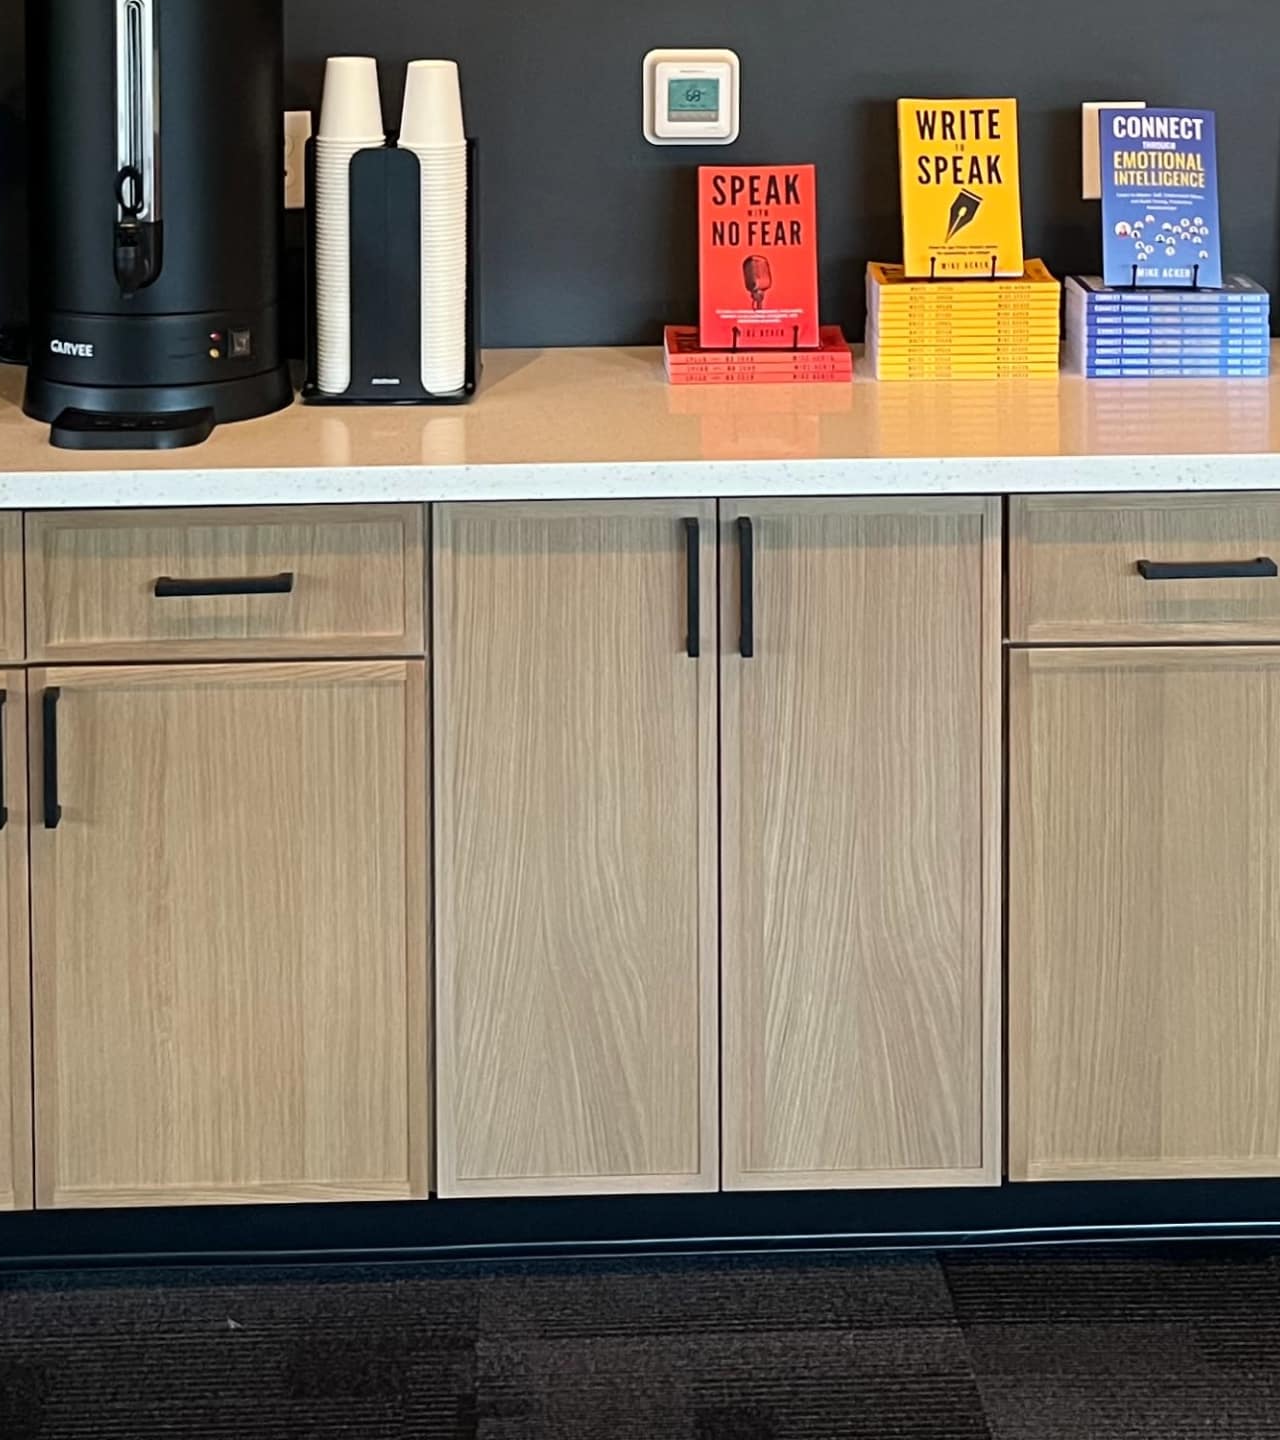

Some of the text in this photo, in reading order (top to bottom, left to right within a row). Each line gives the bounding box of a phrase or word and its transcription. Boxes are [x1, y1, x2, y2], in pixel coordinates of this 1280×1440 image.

[915, 109, 1001, 141] WRITE
[1113, 116, 1204, 140] CONNECT
[918, 155, 1002, 185] SPEAK
[1113, 151, 1205, 171] EMOTIONAL
[712, 174, 800, 206] SPEAK
[1114, 170, 1205, 189] INTELLIGENCE
[712, 220, 802, 247] NO FEAR
[1136, 267, 1158, 278] MIKE
